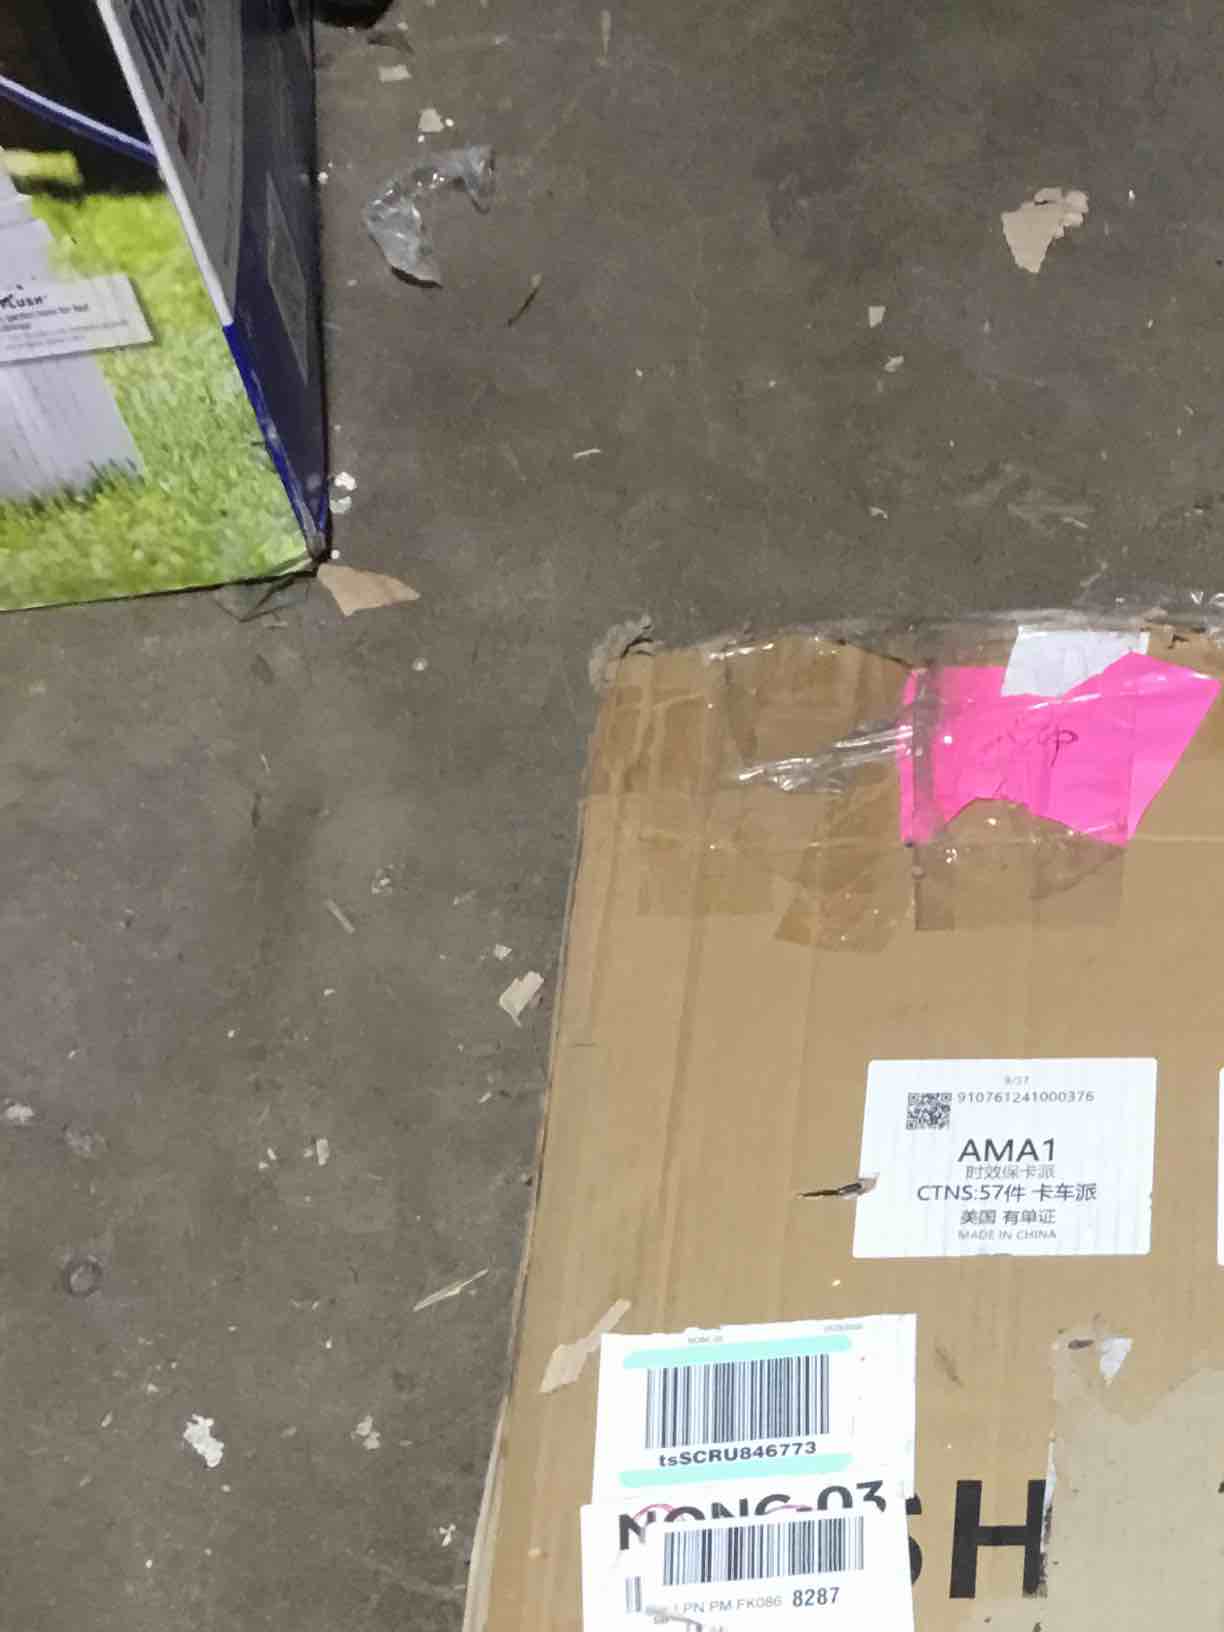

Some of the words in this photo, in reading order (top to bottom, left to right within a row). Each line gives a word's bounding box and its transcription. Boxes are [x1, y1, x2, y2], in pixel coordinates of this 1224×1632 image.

[957, 1090, 1095, 1103] 910761241000376
[957, 1137, 1056, 1163] AMA1
[1031, 1182, 1097, 1202] 卡车派
[960, 1209, 997, 1225] 美国
[1003, 1208, 1056, 1225] 有单证
[957, 1229, 995, 1240] MADE
[999, 1230, 1013, 1240] IN
[1016, 1229, 1057, 1240] CHINA
[658, 1440, 818, 1468] tsSCRU846773
[792, 1586, 840, 1608] 8287
